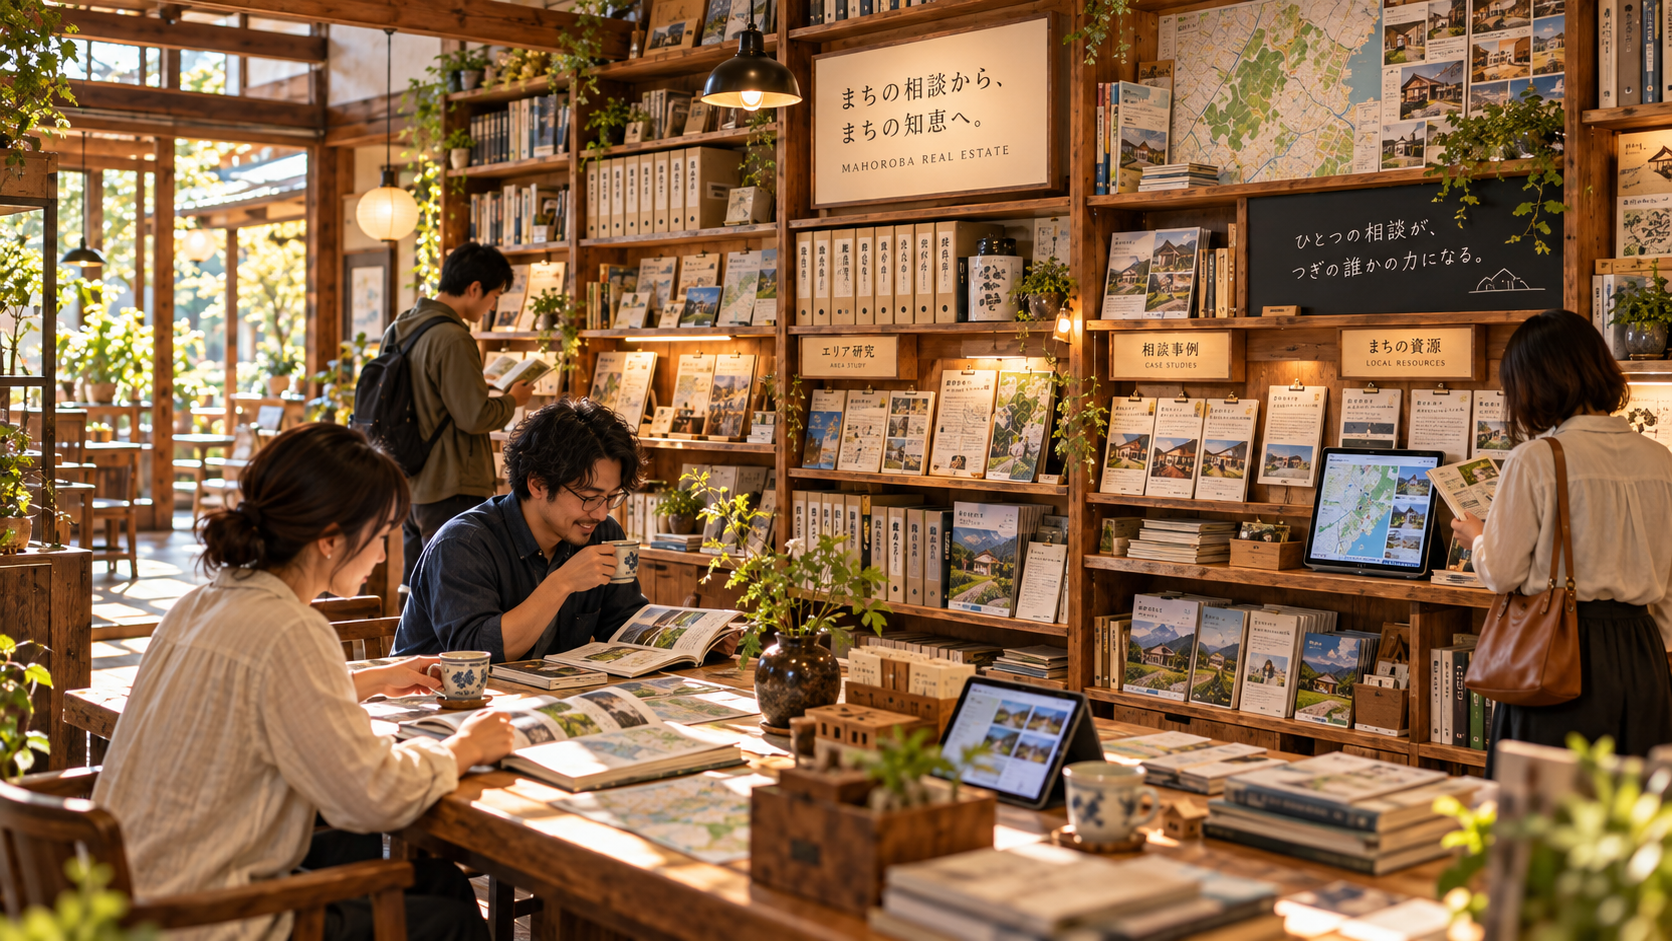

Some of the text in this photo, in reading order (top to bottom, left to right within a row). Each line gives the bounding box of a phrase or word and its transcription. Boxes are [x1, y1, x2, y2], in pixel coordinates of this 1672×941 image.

[842, 67, 1003, 110] まちの相談から、
[842, 108, 981, 144] まちの知恵へ。
[841, 145, 1009, 173] MAHOROBA REAL ESTATE
[1295, 218, 1435, 250] ひとつの相談が、
[1292, 246, 1482, 280] つぎの誰かの力になる。
[822, 345, 875, 358] エリア研究
[1369, 337, 1442, 354] まちの資源
[1145, 361, 1197, 369] CASE STUDIES
[1366, 359, 1446, 367] LOCAL RESOURCES
